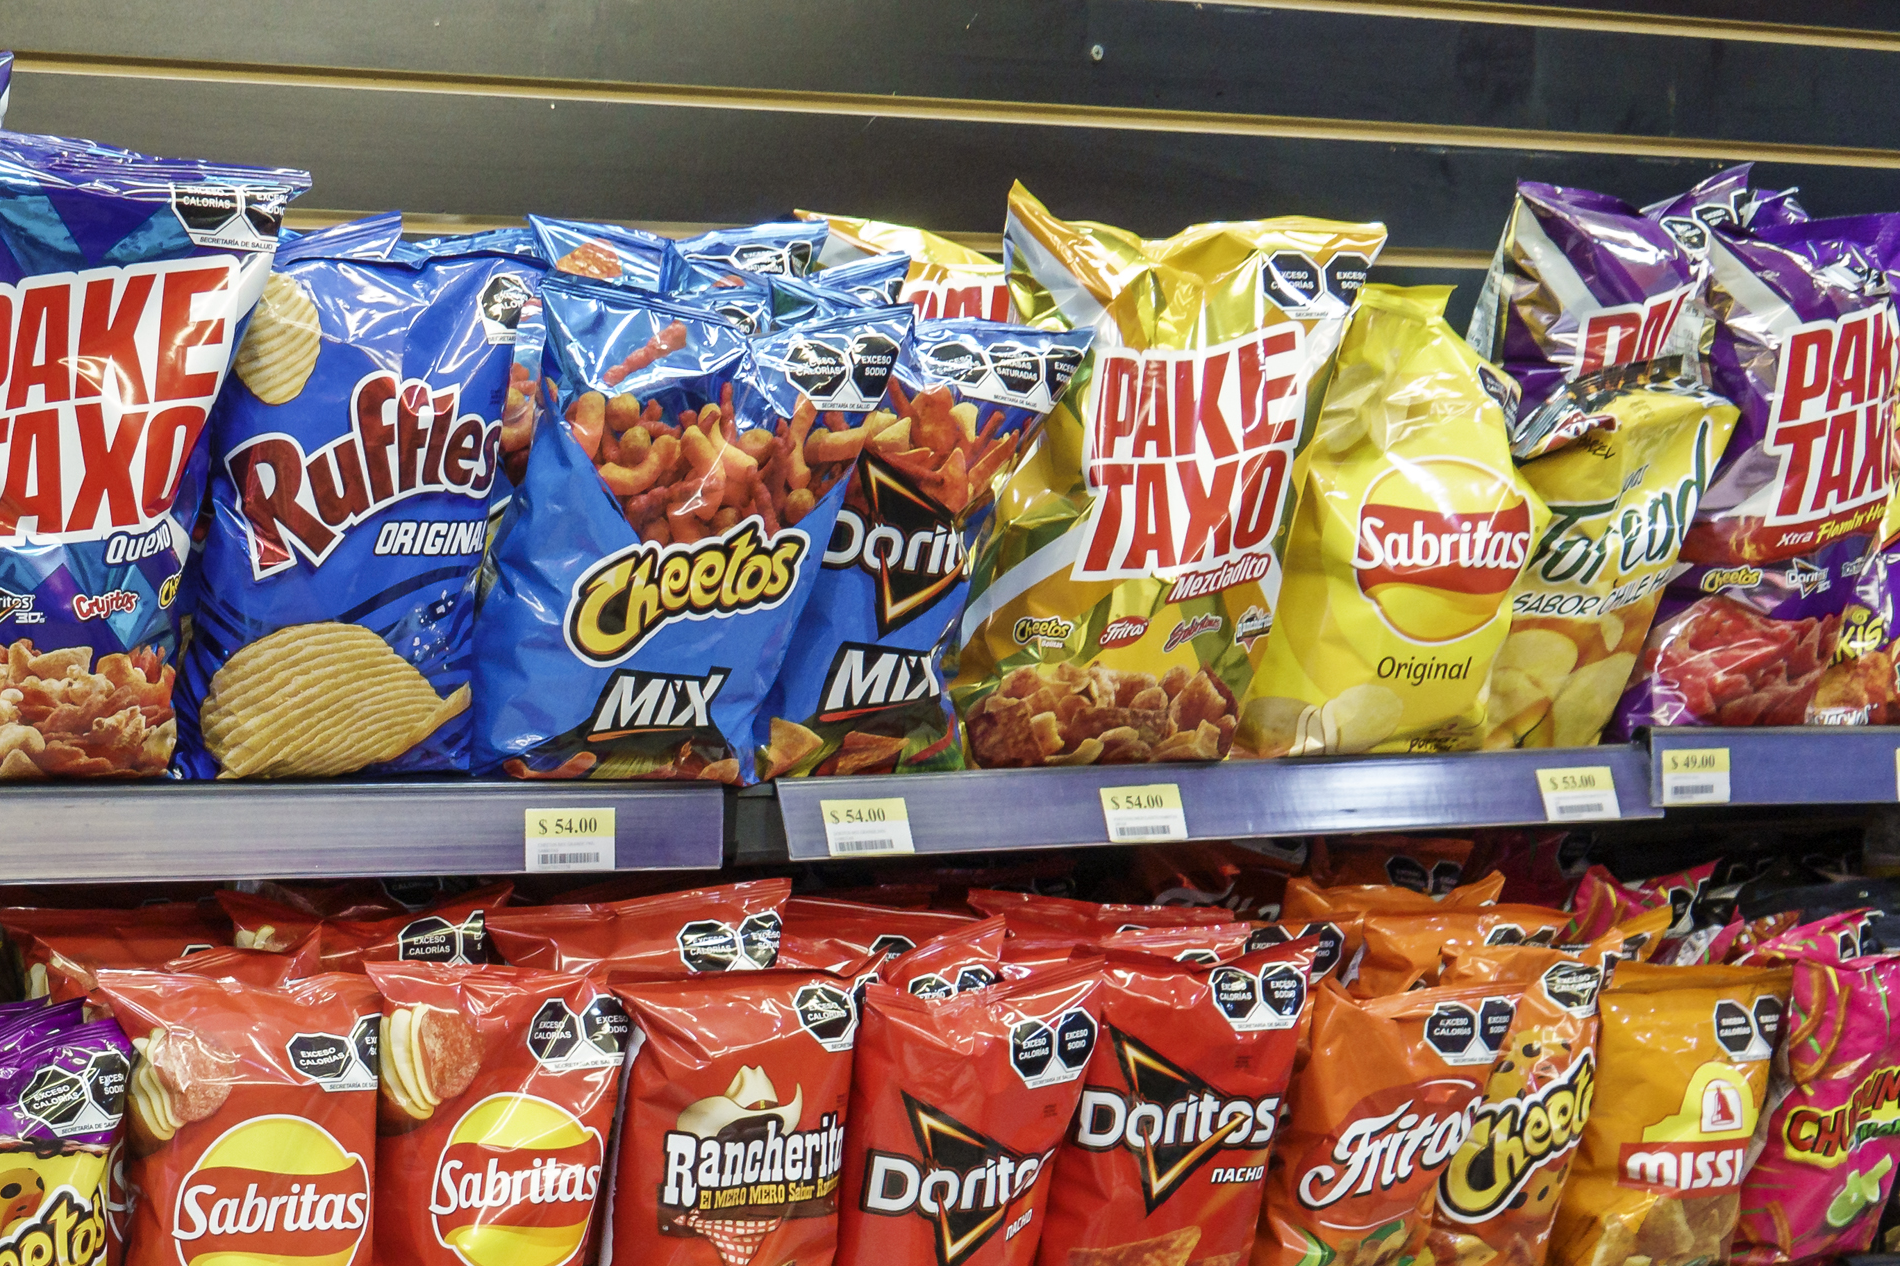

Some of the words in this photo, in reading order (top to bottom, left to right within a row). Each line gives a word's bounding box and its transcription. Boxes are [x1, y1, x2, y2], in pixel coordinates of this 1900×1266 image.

[1101, 330, 1298, 461] PAKE
[227, 373, 502, 578] Ruffles
[376, 520, 486, 555] ORIGINAL
[1083, 447, 1288, 574] TAXO
[1353, 516, 1530, 571] Sabritas
[75, 590, 138, 620] Crujitos
[576, 522, 804, 662] Cheetos
[1174, 555, 1270, 601] Mezcladito
[1014, 616, 1073, 644] Cheetos
[1376, 654, 1474, 687] Original
[538, 820, 548, 835] $
[555, 817, 598, 834] 54.00
[829, 811, 840, 825] $
[845, 808, 886, 824] 54.00
[1077, 1091, 1281, 1148] Doritos
[1299, 1098, 1484, 1211] Fritos
[172, 1183, 368, 1240] Sabritas
[429, 1157, 600, 1214] Sabritas
